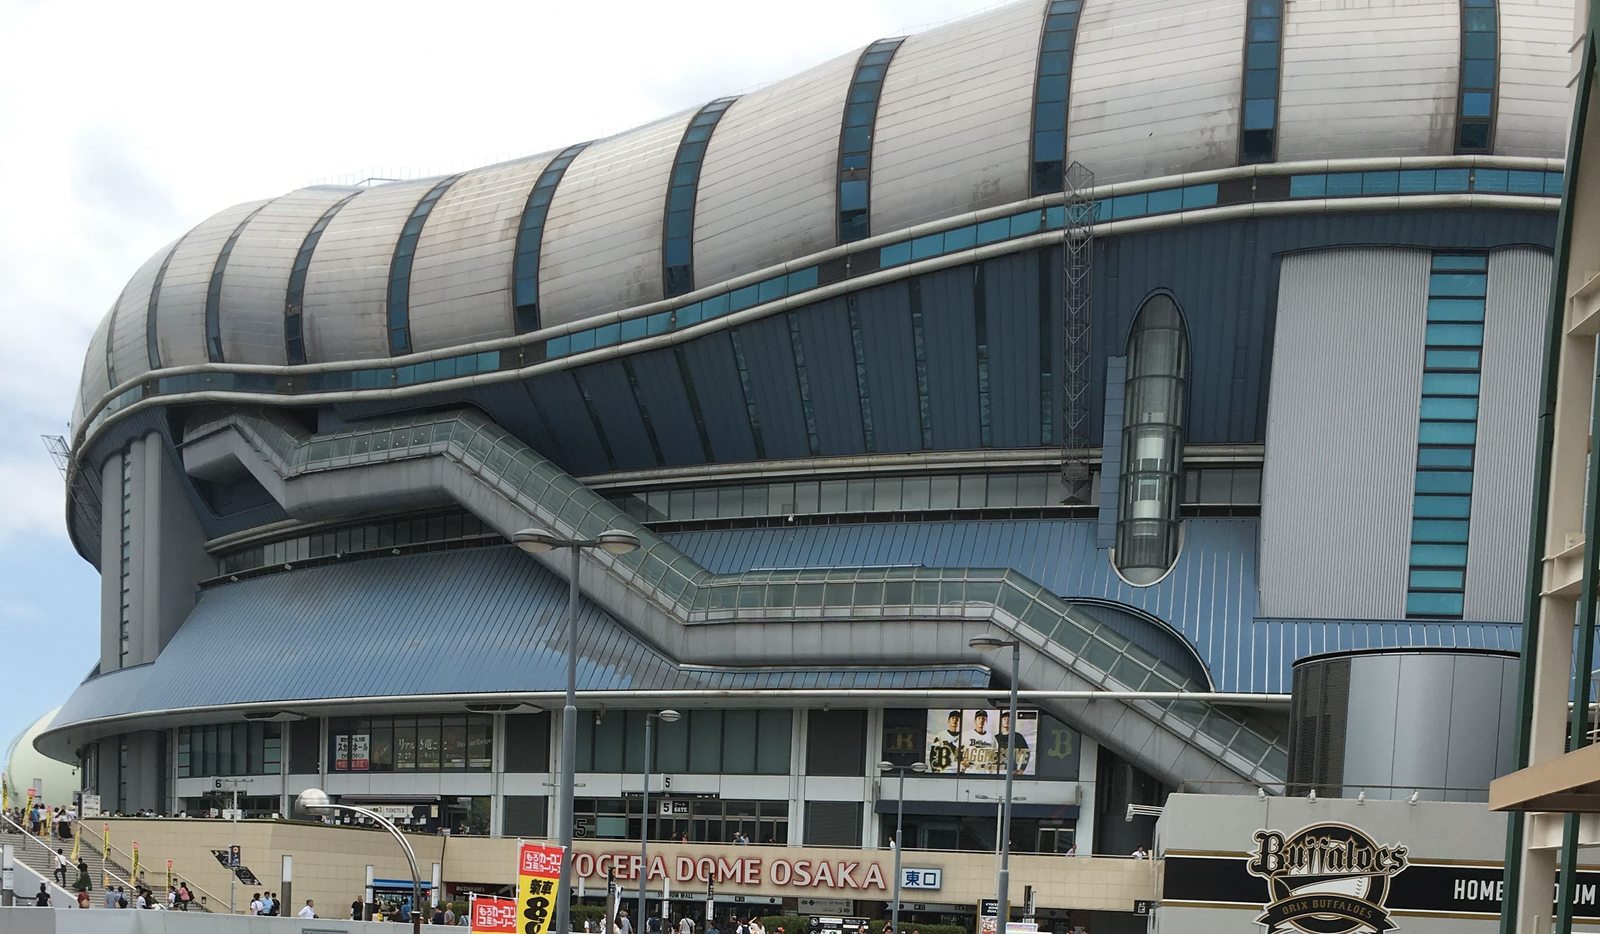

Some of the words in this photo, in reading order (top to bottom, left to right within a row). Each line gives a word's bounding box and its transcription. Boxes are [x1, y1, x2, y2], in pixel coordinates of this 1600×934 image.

[215, 779, 222, 788] 6
[665, 777, 671, 788] 5
[663, 802, 670, 813] 5
[575, 818, 587, 838] 5
[1247, 830, 1408, 876] Buffaloes
[675, 855, 763, 885] DOME
[769, 858, 887, 890] OSAKA
[904, 870, 937, 887] 東口
[529, 878, 555, 896] 新車
[1453, 879, 1504, 902] HOME
[1281, 900, 1309, 916] ORIX
[1311, 899, 1374, 920] BUFFALOES
